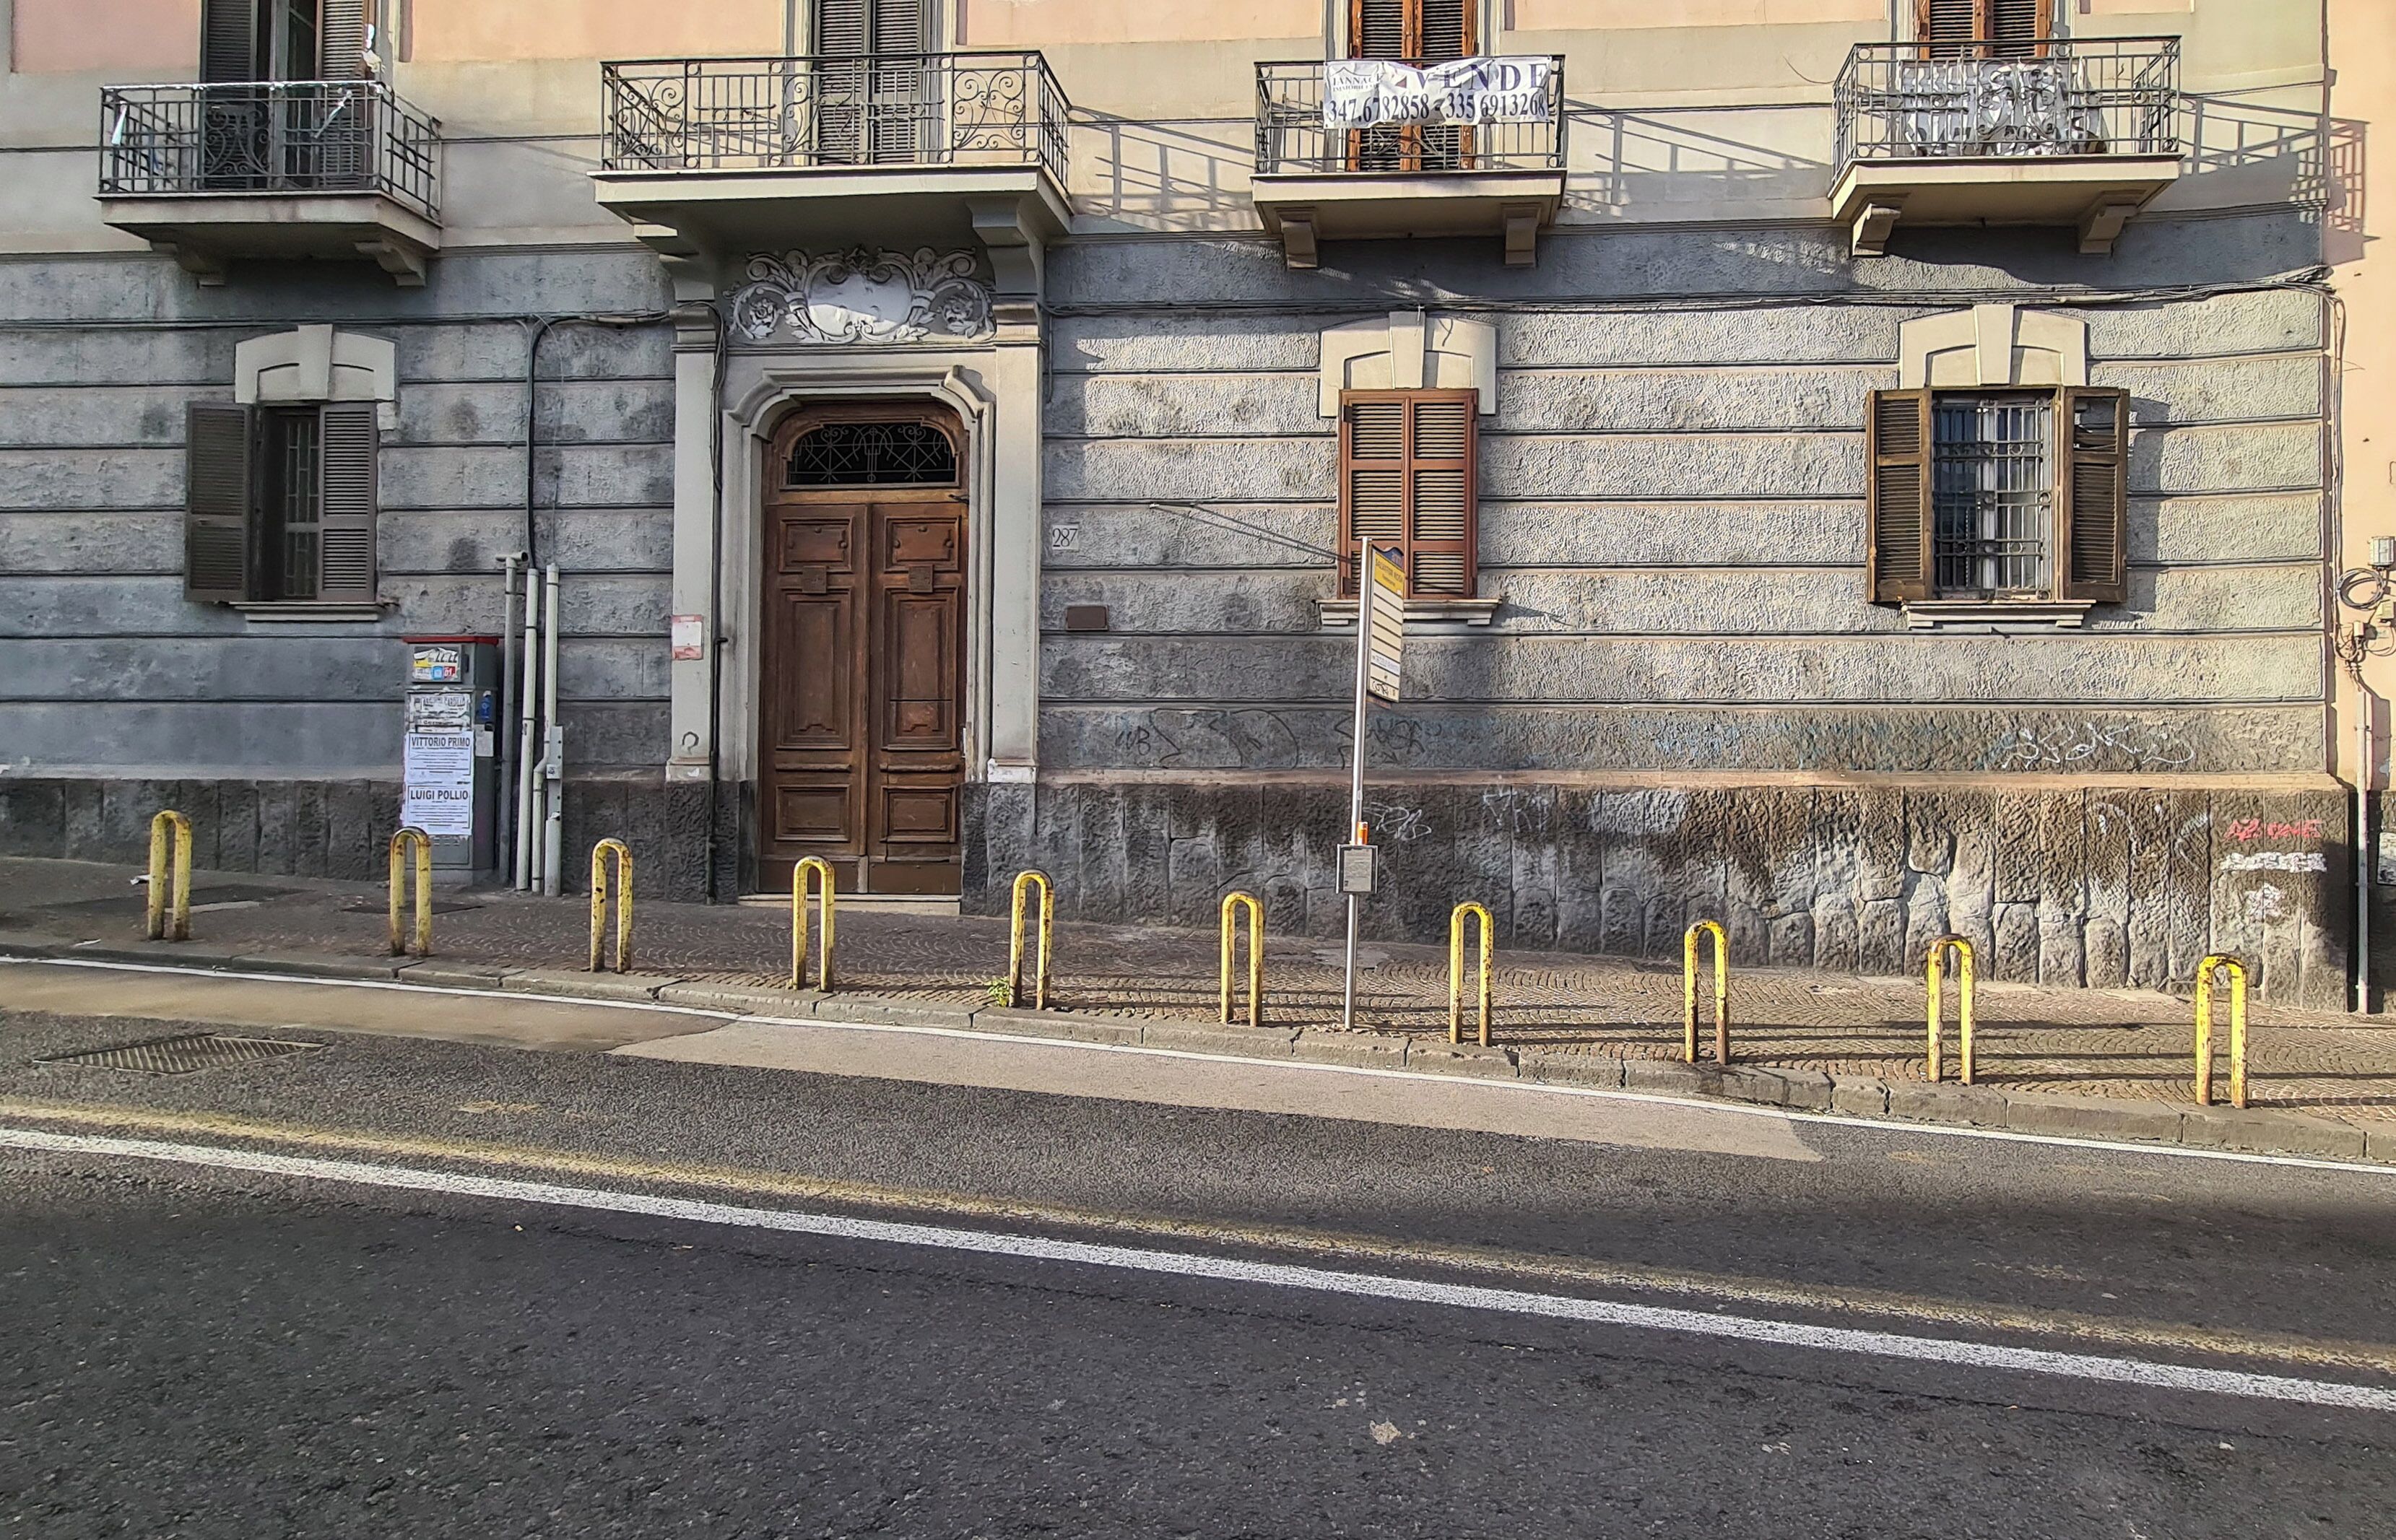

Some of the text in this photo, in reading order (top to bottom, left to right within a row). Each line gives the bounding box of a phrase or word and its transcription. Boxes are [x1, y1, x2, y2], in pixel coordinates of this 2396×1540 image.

[1417, 63, 1548, 91] VENDE
[1329, 93, 1430, 122] 347.6782858
[1053, 528, 1077, 547] 287
[412, 737, 470, 747] VITTORIO PRIMO
[410, 790, 469, 800] LUIGI POLLIO
